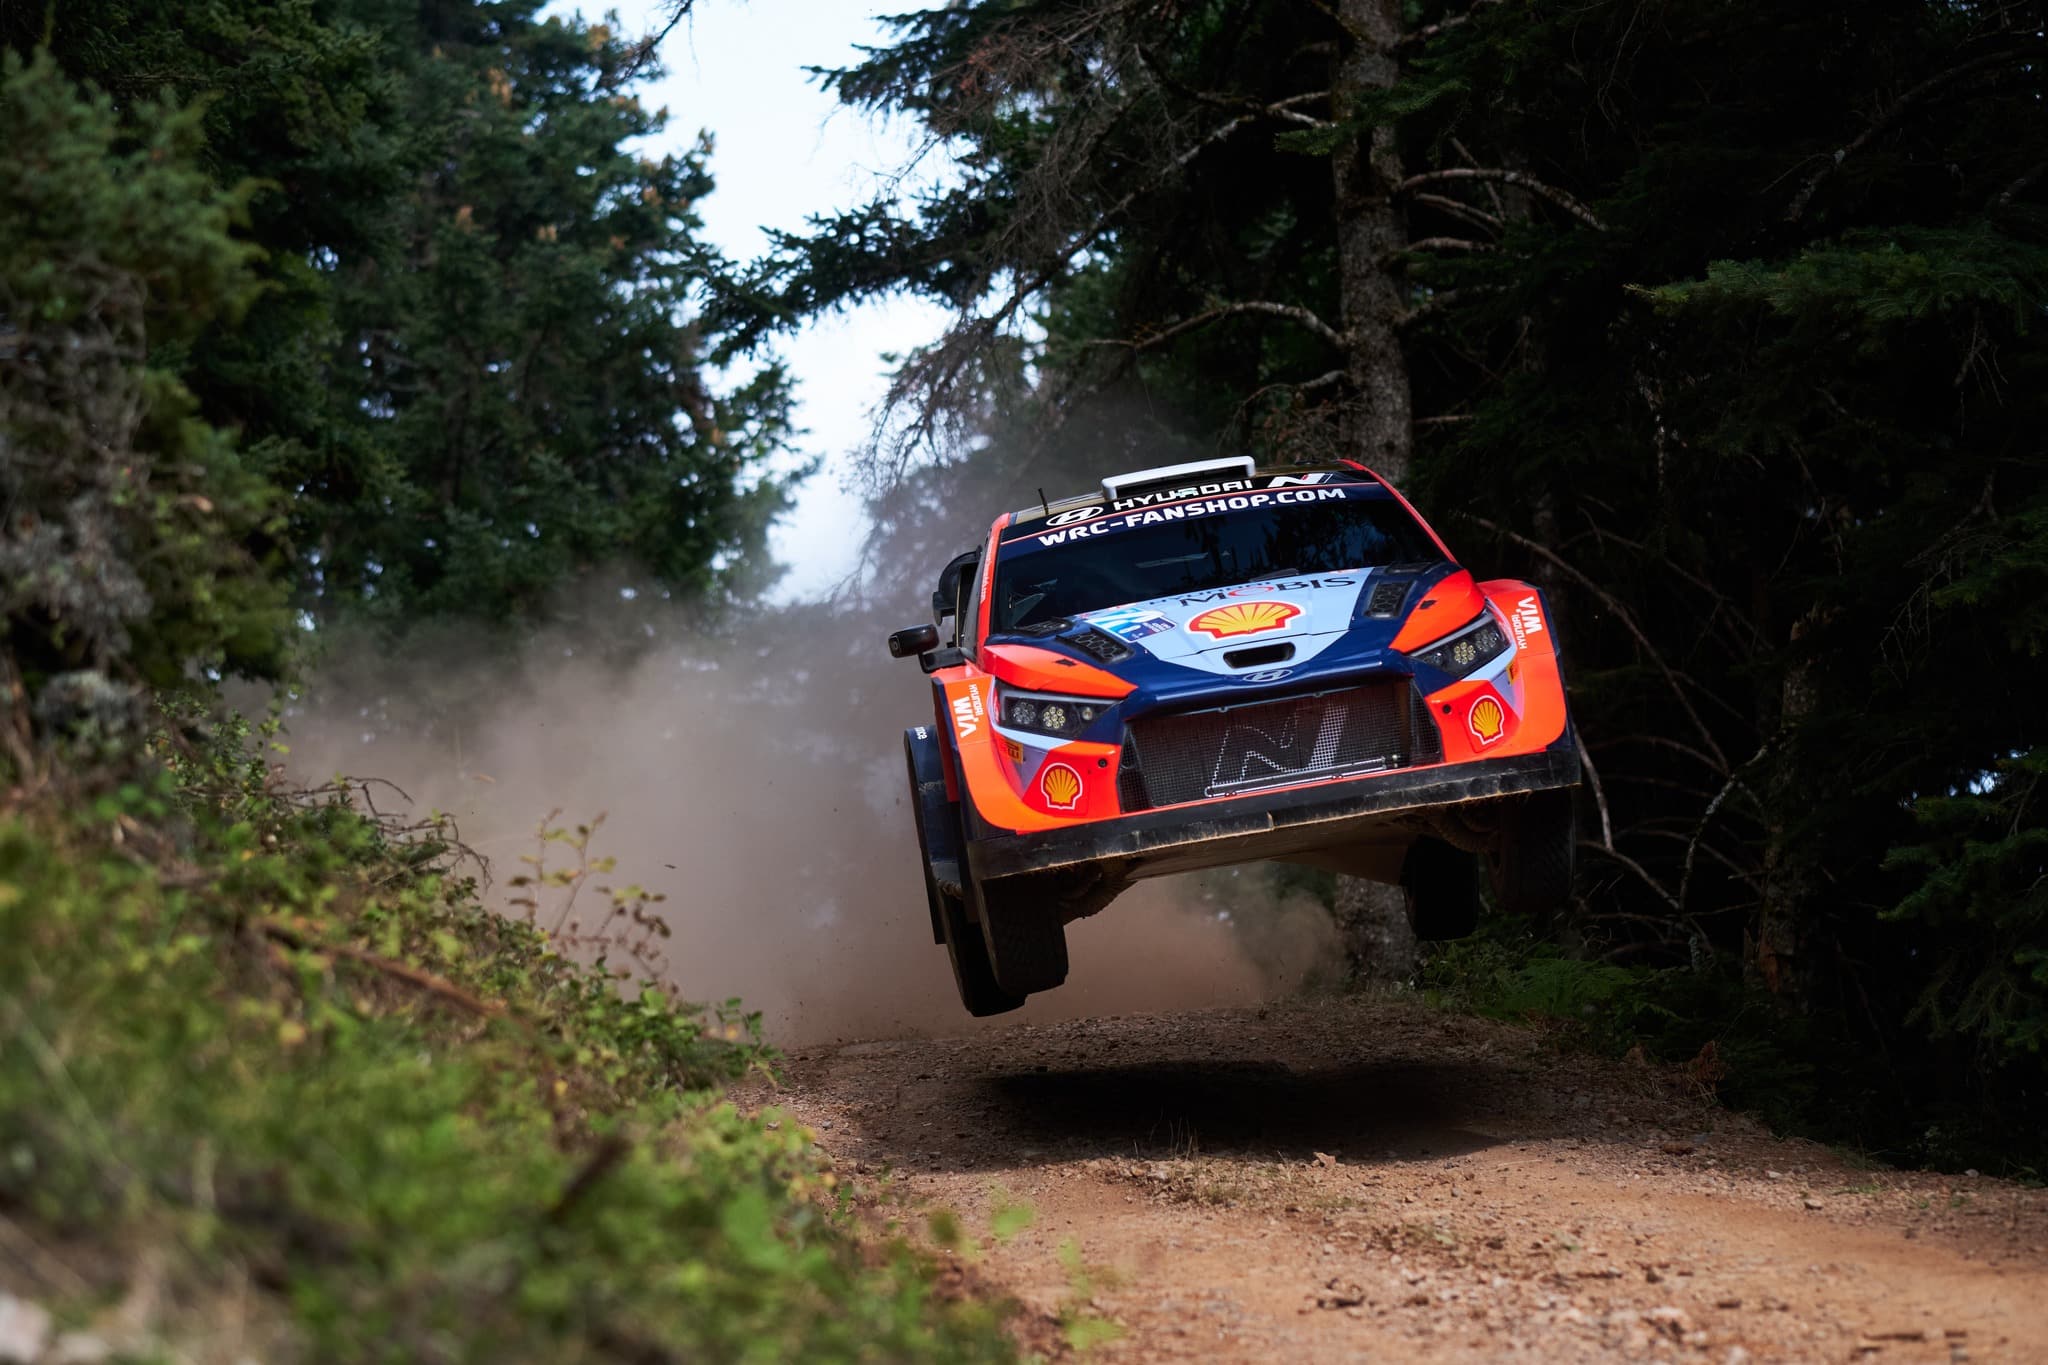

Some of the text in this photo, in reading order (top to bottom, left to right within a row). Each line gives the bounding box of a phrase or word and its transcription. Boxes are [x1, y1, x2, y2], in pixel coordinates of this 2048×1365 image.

[1113, 479, 1253, 511] HYUNDAI
[1038, 488, 1346, 546] WRC-FANSHOP.COM
[1178, 577, 1356, 607] MOBIS
[1511, 613, 1528, 650] HYUNDAI
[968, 683, 984, 717] HYUNDAI
